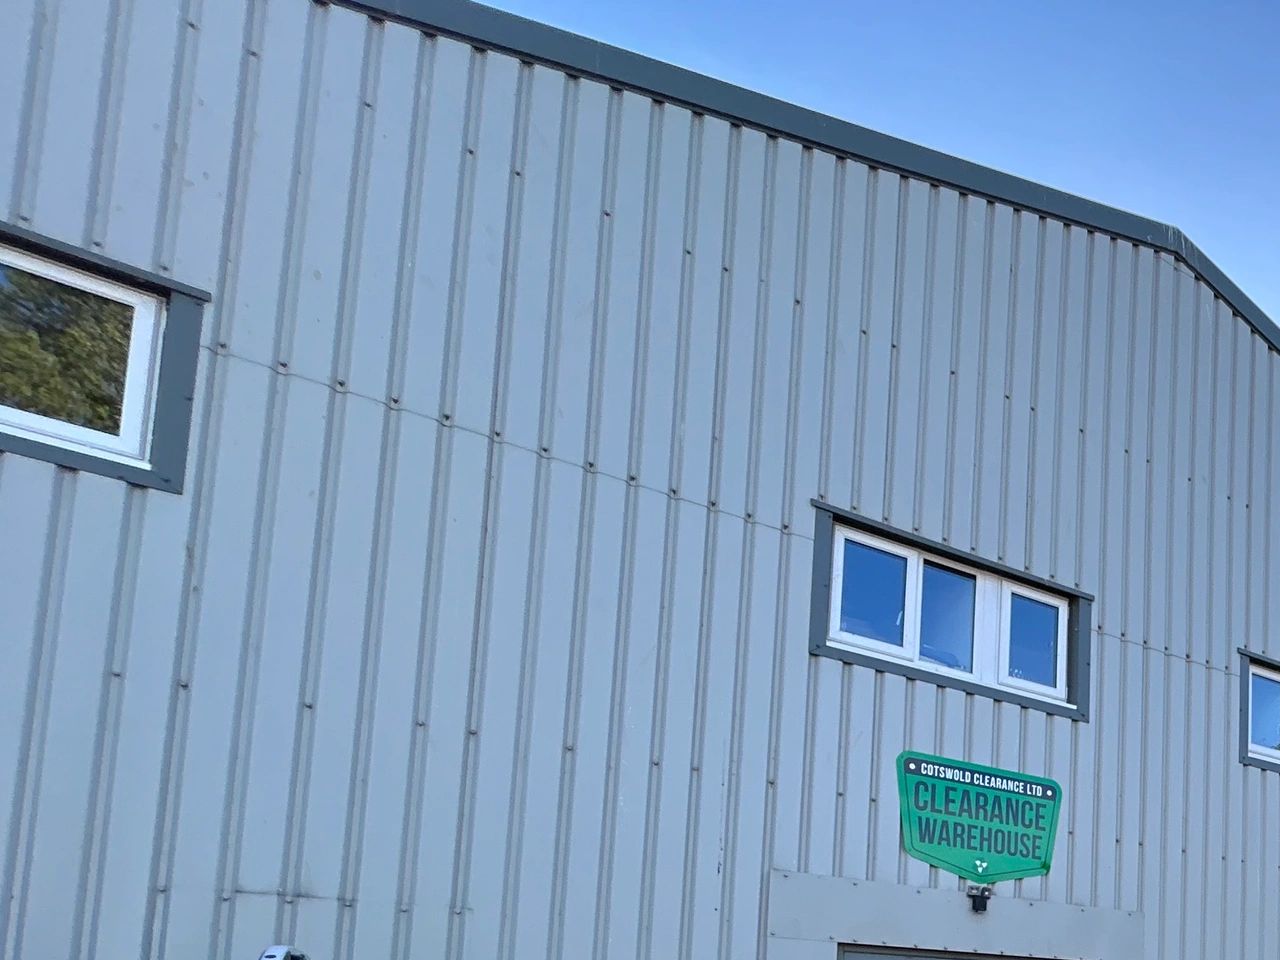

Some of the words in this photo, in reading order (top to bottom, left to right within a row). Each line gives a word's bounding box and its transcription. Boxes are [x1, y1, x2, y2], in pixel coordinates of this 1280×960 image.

[921, 762, 971, 783] COTSWOLD
[973, 773, 1024, 794] CLEARANCE
[1026, 783, 1043, 797] LTD
[914, 781, 1047, 832] CLEARANCE
[917, 816, 1043, 860] WAREHOUSE
